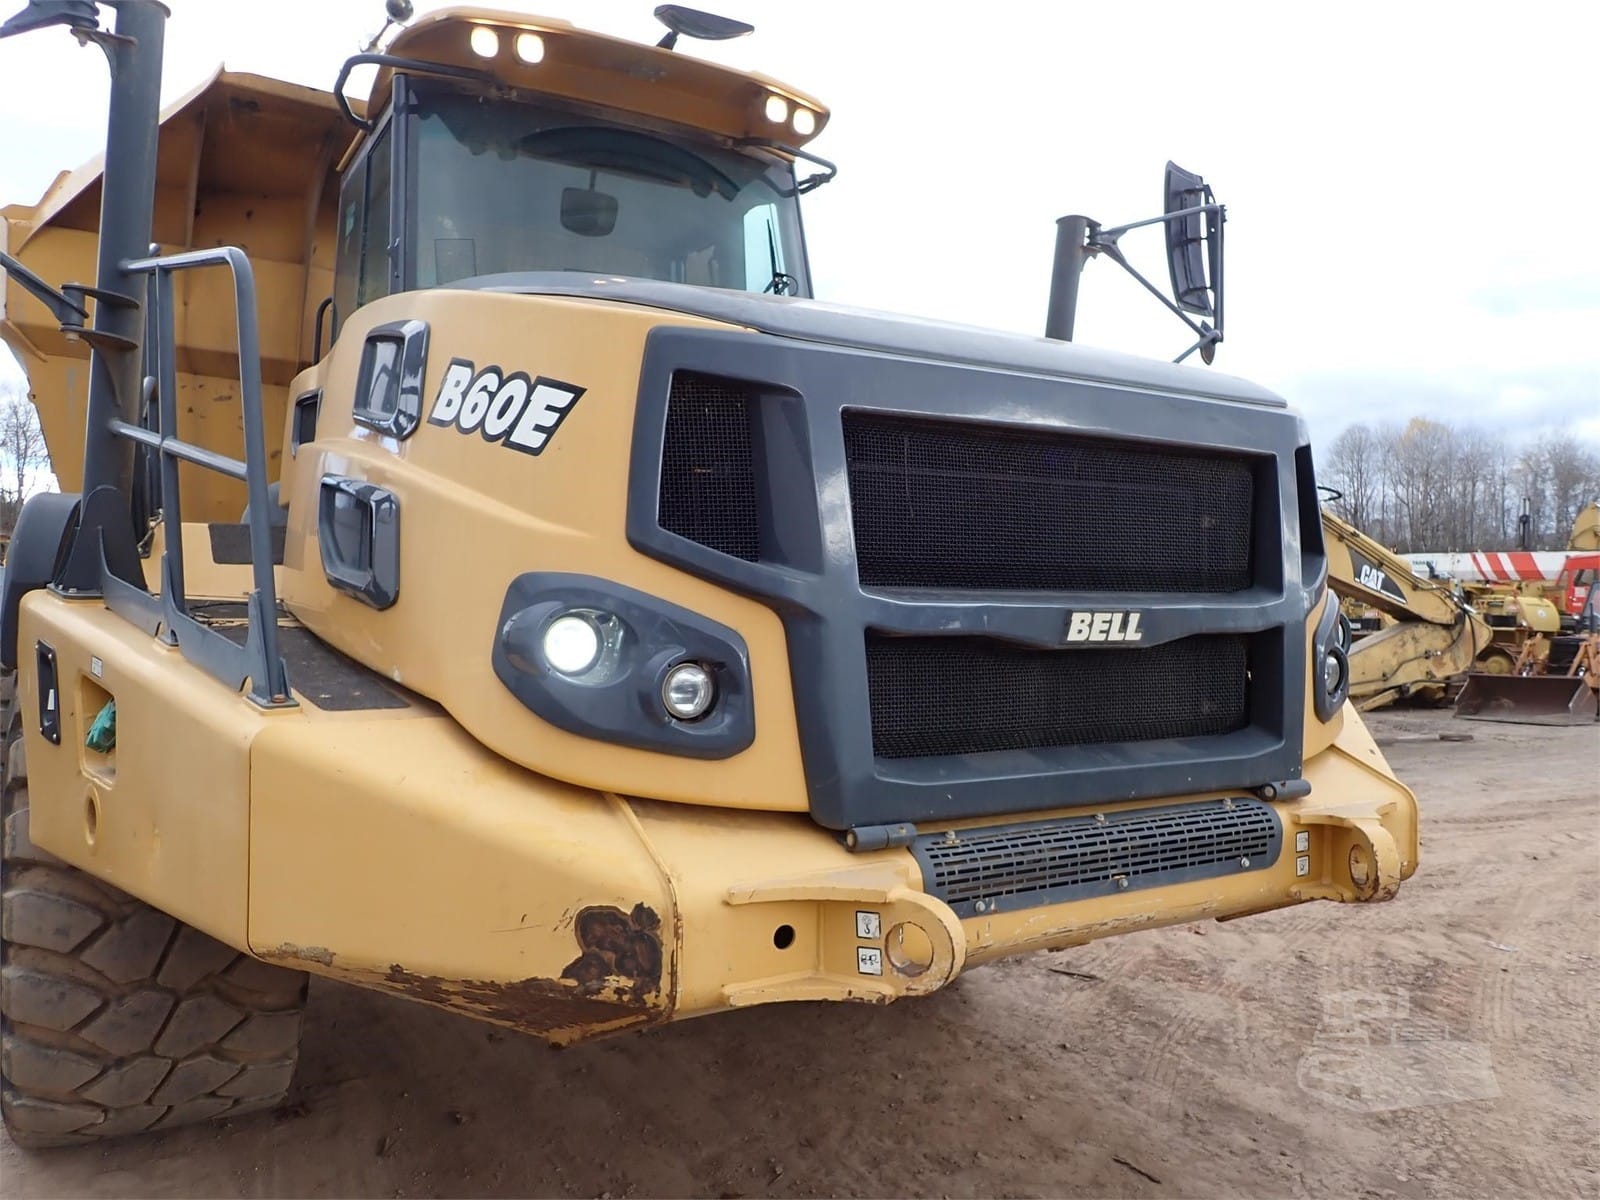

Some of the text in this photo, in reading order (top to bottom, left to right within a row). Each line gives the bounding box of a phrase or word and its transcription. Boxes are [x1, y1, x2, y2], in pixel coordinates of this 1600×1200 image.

[431, 364, 576, 449] B60E
[1360, 564, 1385, 591] CAT
[1066, 612, 1143, 641] BELL
